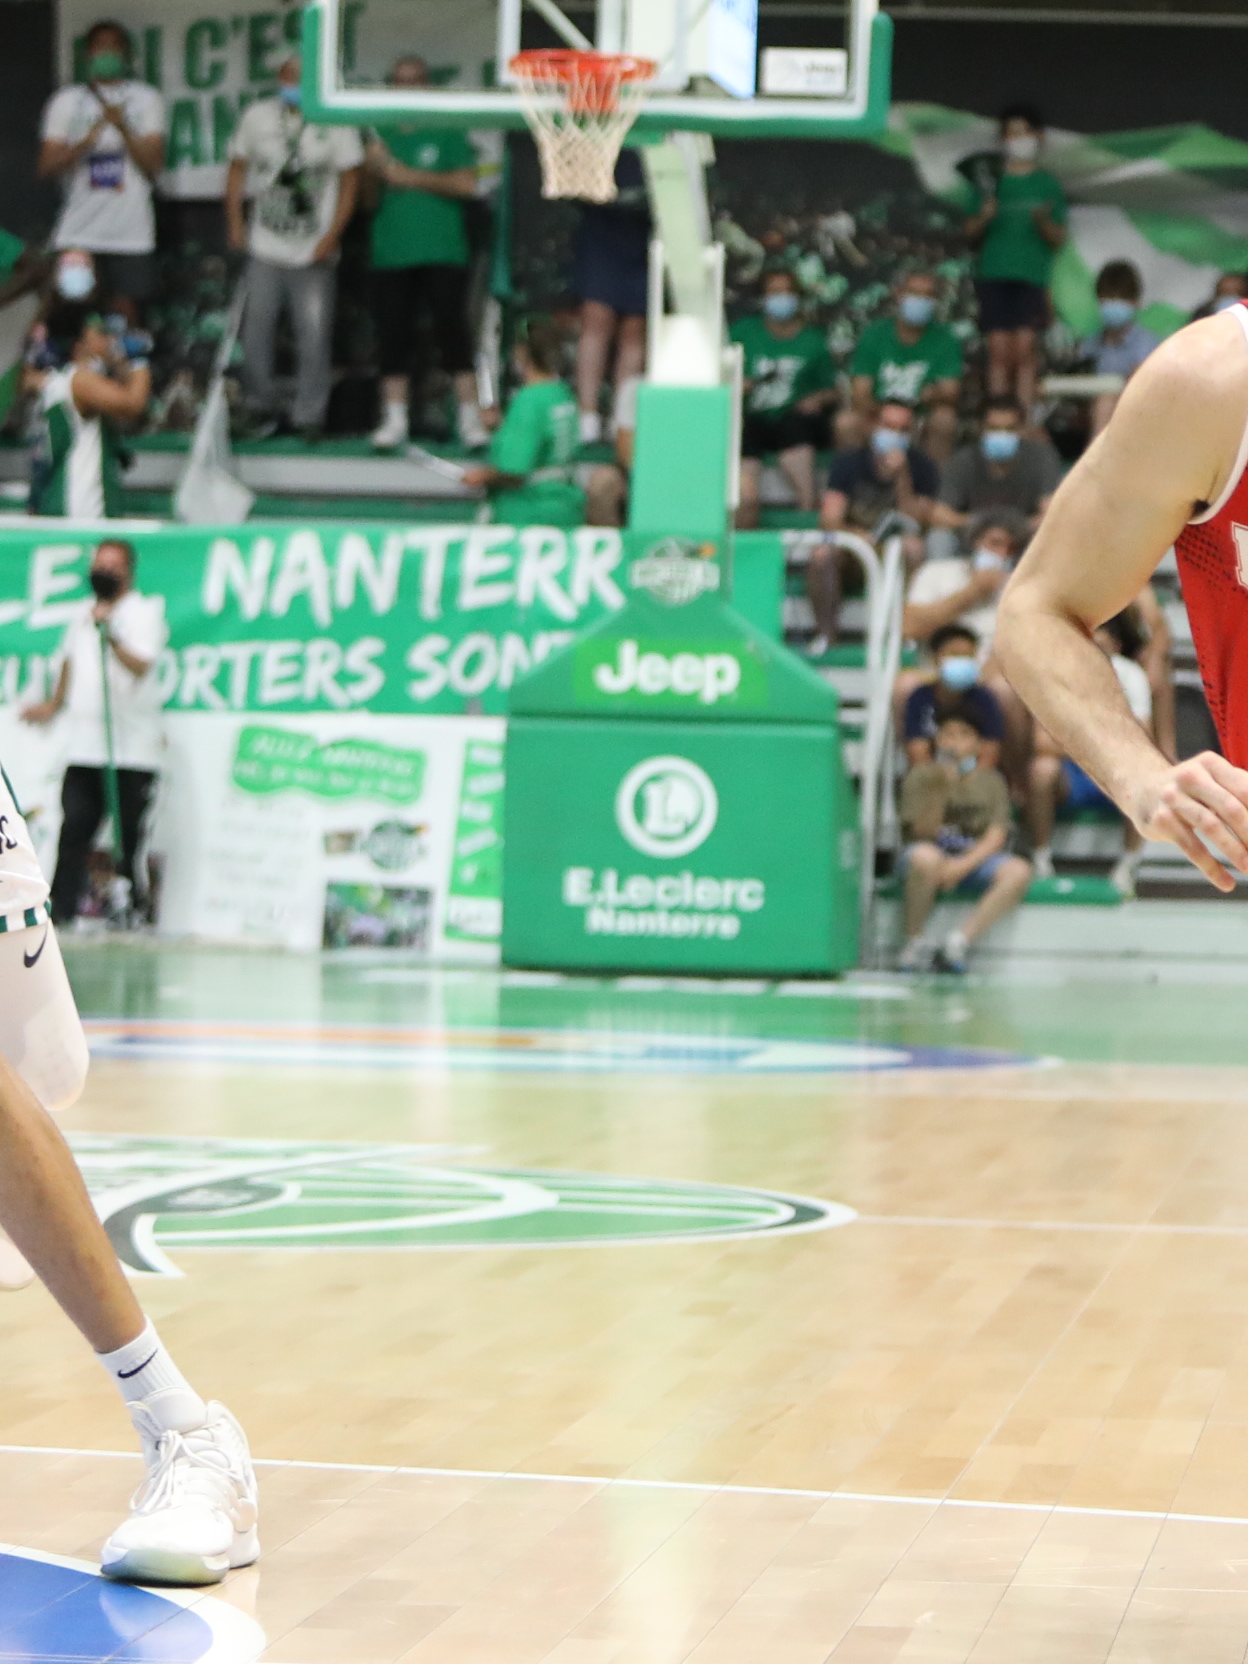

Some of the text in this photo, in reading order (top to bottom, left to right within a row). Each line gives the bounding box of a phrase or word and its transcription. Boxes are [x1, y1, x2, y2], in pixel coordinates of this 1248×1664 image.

[203, 525, 627, 630] NANTERR
[594, 638, 741, 705] Jeep
[562, 865, 767, 912] E.Leclerc
[584, 906, 742, 940] Nanterre
